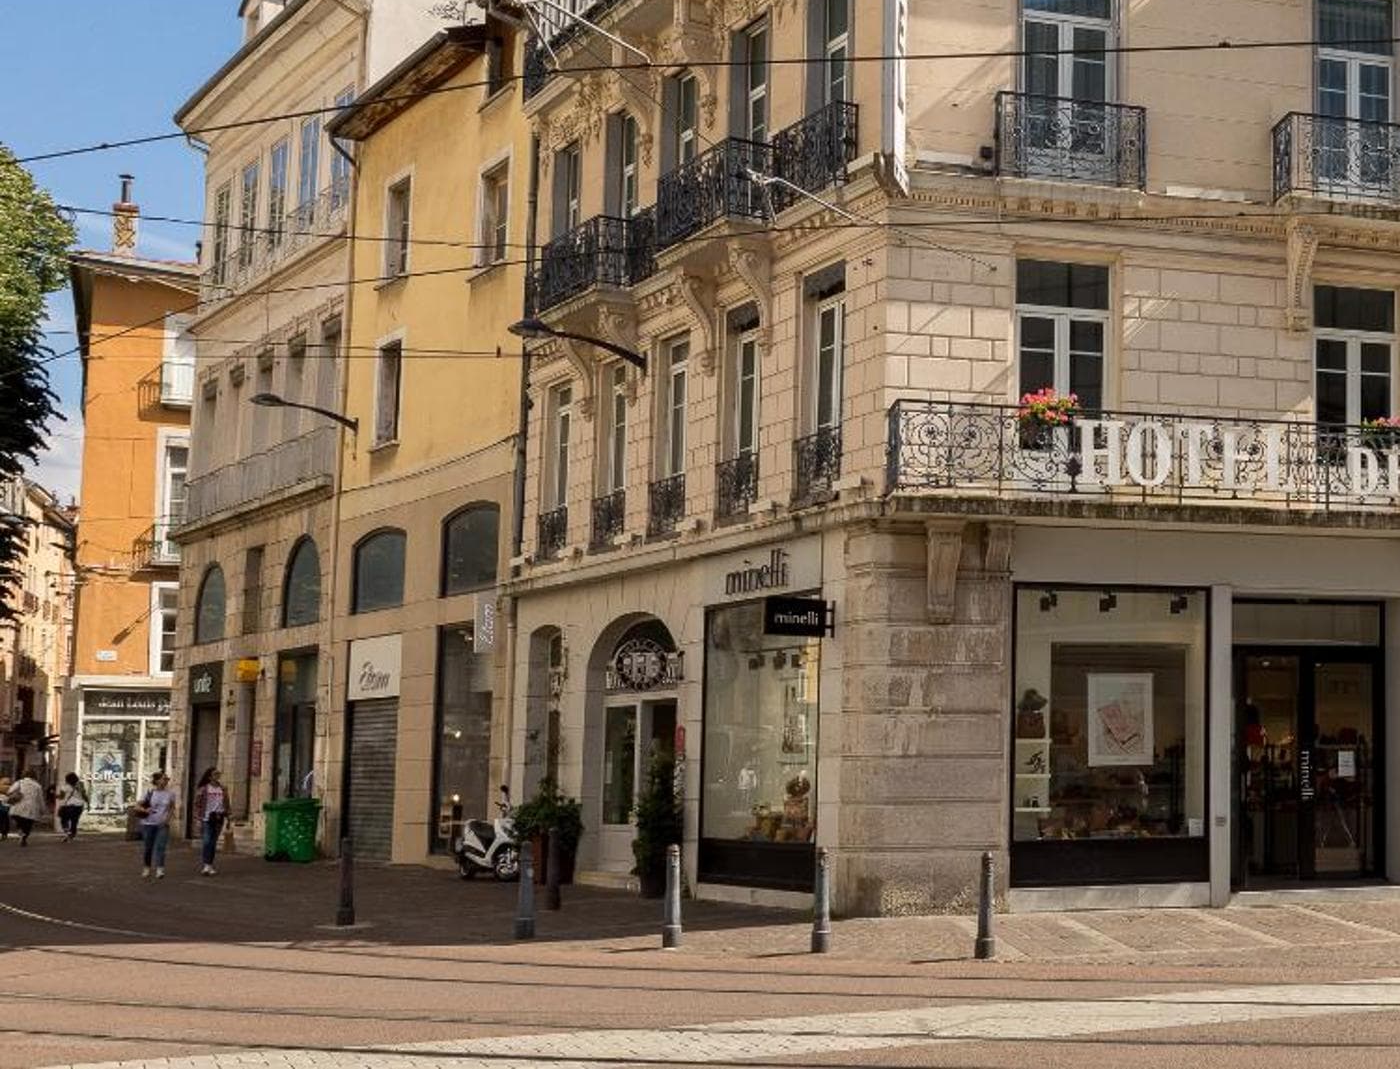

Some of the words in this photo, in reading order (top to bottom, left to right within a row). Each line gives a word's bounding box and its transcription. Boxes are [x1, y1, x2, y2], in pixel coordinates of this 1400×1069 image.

[1077, 419, 1295, 492] HOTEL
[725, 547, 788, 596] minelli
[773, 611, 819, 627] minelli
[1300, 750, 1314, 801] minelli
